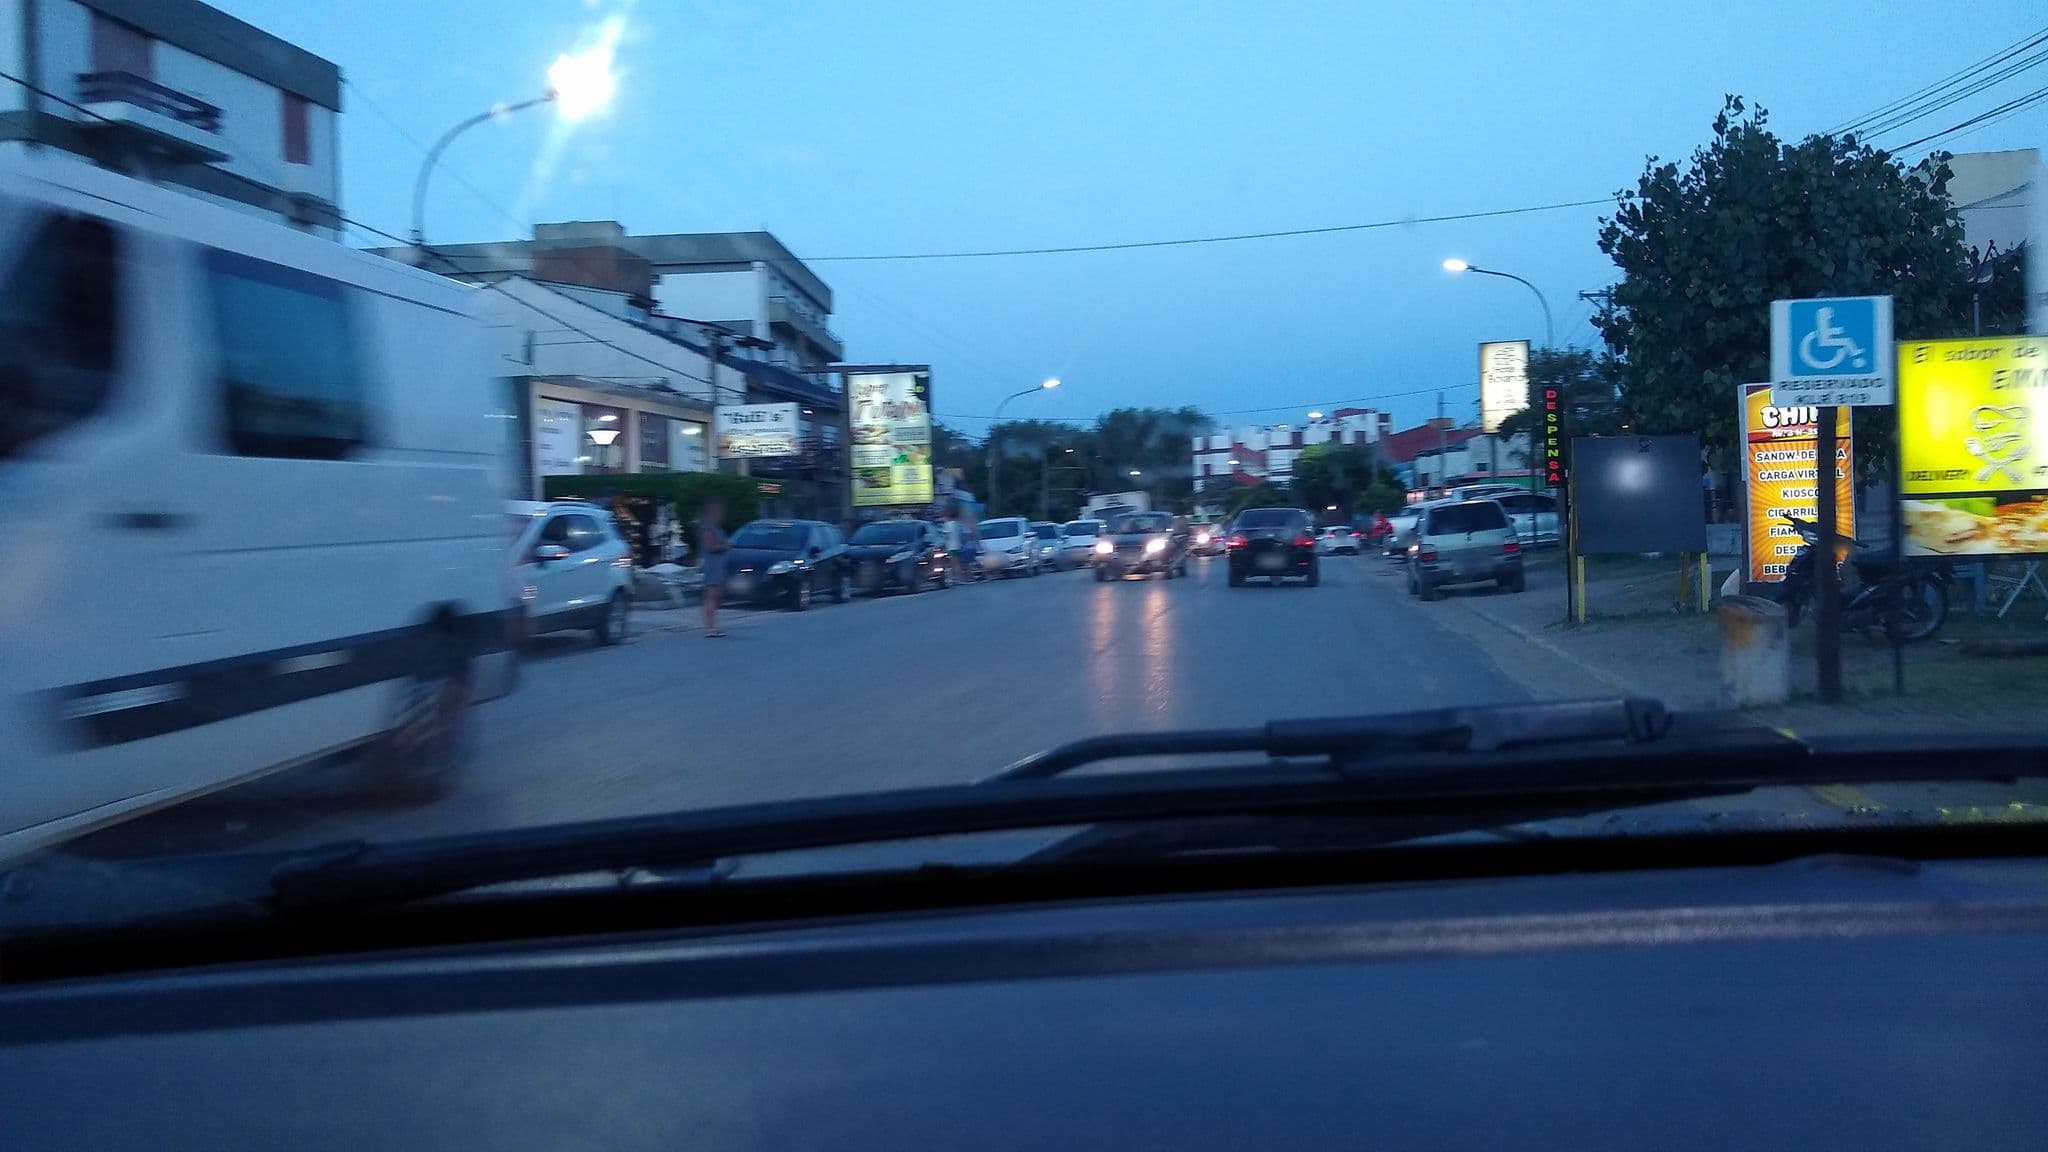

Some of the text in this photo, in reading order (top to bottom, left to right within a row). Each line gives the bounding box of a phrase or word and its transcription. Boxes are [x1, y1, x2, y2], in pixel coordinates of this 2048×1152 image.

[1778, 377, 1884, 391] RESERVADO
[1546, 390, 1560, 481] DESPENSA
[1801, 451, 1815, 459] DE
[1759, 471, 1795, 480] CARGA
